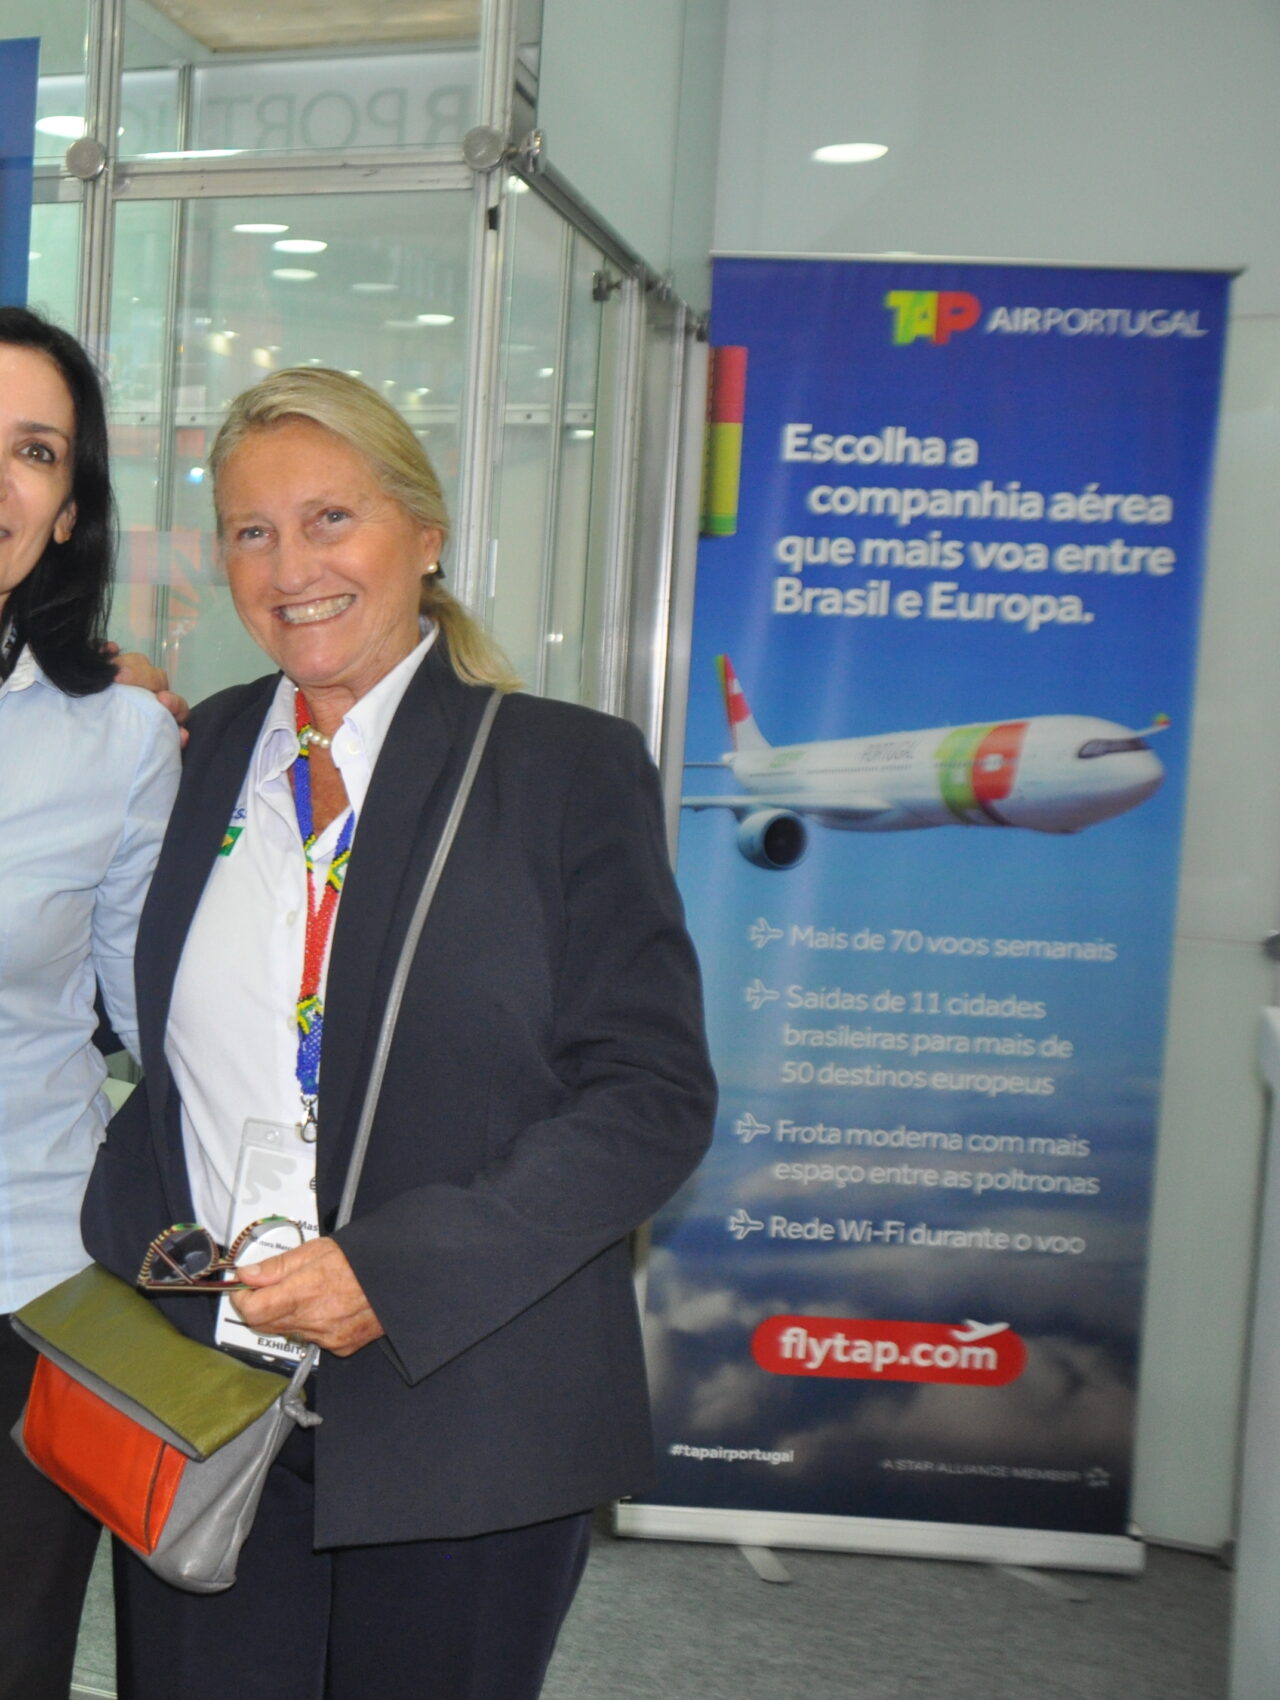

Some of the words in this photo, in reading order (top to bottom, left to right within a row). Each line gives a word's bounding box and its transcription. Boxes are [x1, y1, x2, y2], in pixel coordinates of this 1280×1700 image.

[883, 290, 982, 346] TAP
[781, 423, 946, 466] Escolha
[949, 438, 979, 467] a
[807, 481, 1044, 527] companhia
[1048, 483, 1173, 524] aérea
[776, 535, 856, 573] que
[861, 531, 964, 568] mais
[968, 541, 1049, 572] voa
[1053, 539, 1177, 576] entre
[773, 577, 891, 617] Brasil
[895, 589, 923, 617] e
[928, 582, 1095, 632] Europa.
[789, 925, 848, 951] Mais
[852, 928, 885, 952] de
[889, 929, 924, 953] 70
[927, 936, 990, 956] voos
[994, 938, 1118, 962] semanais
[785, 985, 868, 1011] Saídas
[873, 990, 906, 1013] de
[911, 992, 941, 1015] 11
[946, 993, 1047, 1019] cidades
[782, 1023, 909, 1052] brasileiras
[911, 1032, 972, 1056] para
[973, 1033, 1036, 1057] mais
[1039, 1035, 1074, 1059] de
[780, 1062, 815, 1085] 50
[818, 1064, 927, 1089] destinos
[931, 1072, 1056, 1097] europeus
[775, 1119, 842, 1144] Frota
[845, 1125, 963, 1150] moderna
[967, 1134, 1026, 1154] com
[1029, 1135, 1091, 1157] mais
[774, 1161, 865, 1189] espaço
[870, 1165, 938, 1187] entre
[942, 1170, 973, 1189] as
[976, 1170, 1101, 1195] poltronas
[769, 1216, 835, 1241] Rede
[839, 1219, 906, 1244] Wi-Fi
[910, 1224, 1011, 1249] durante
[1015, 1232, 1033, 1251] o
[1037, 1235, 1086, 1255] voo
[257, 1336, 303, 1356] EXHIBIT
[780, 1326, 999, 1373] flytap.com
[671, 1443, 795, 1466] #tapairportugal
[881, 1459, 894, 1470] A
[895, 1460, 935, 1473] STAR
[938, 1461, 1009, 1477] ALLIANCE
